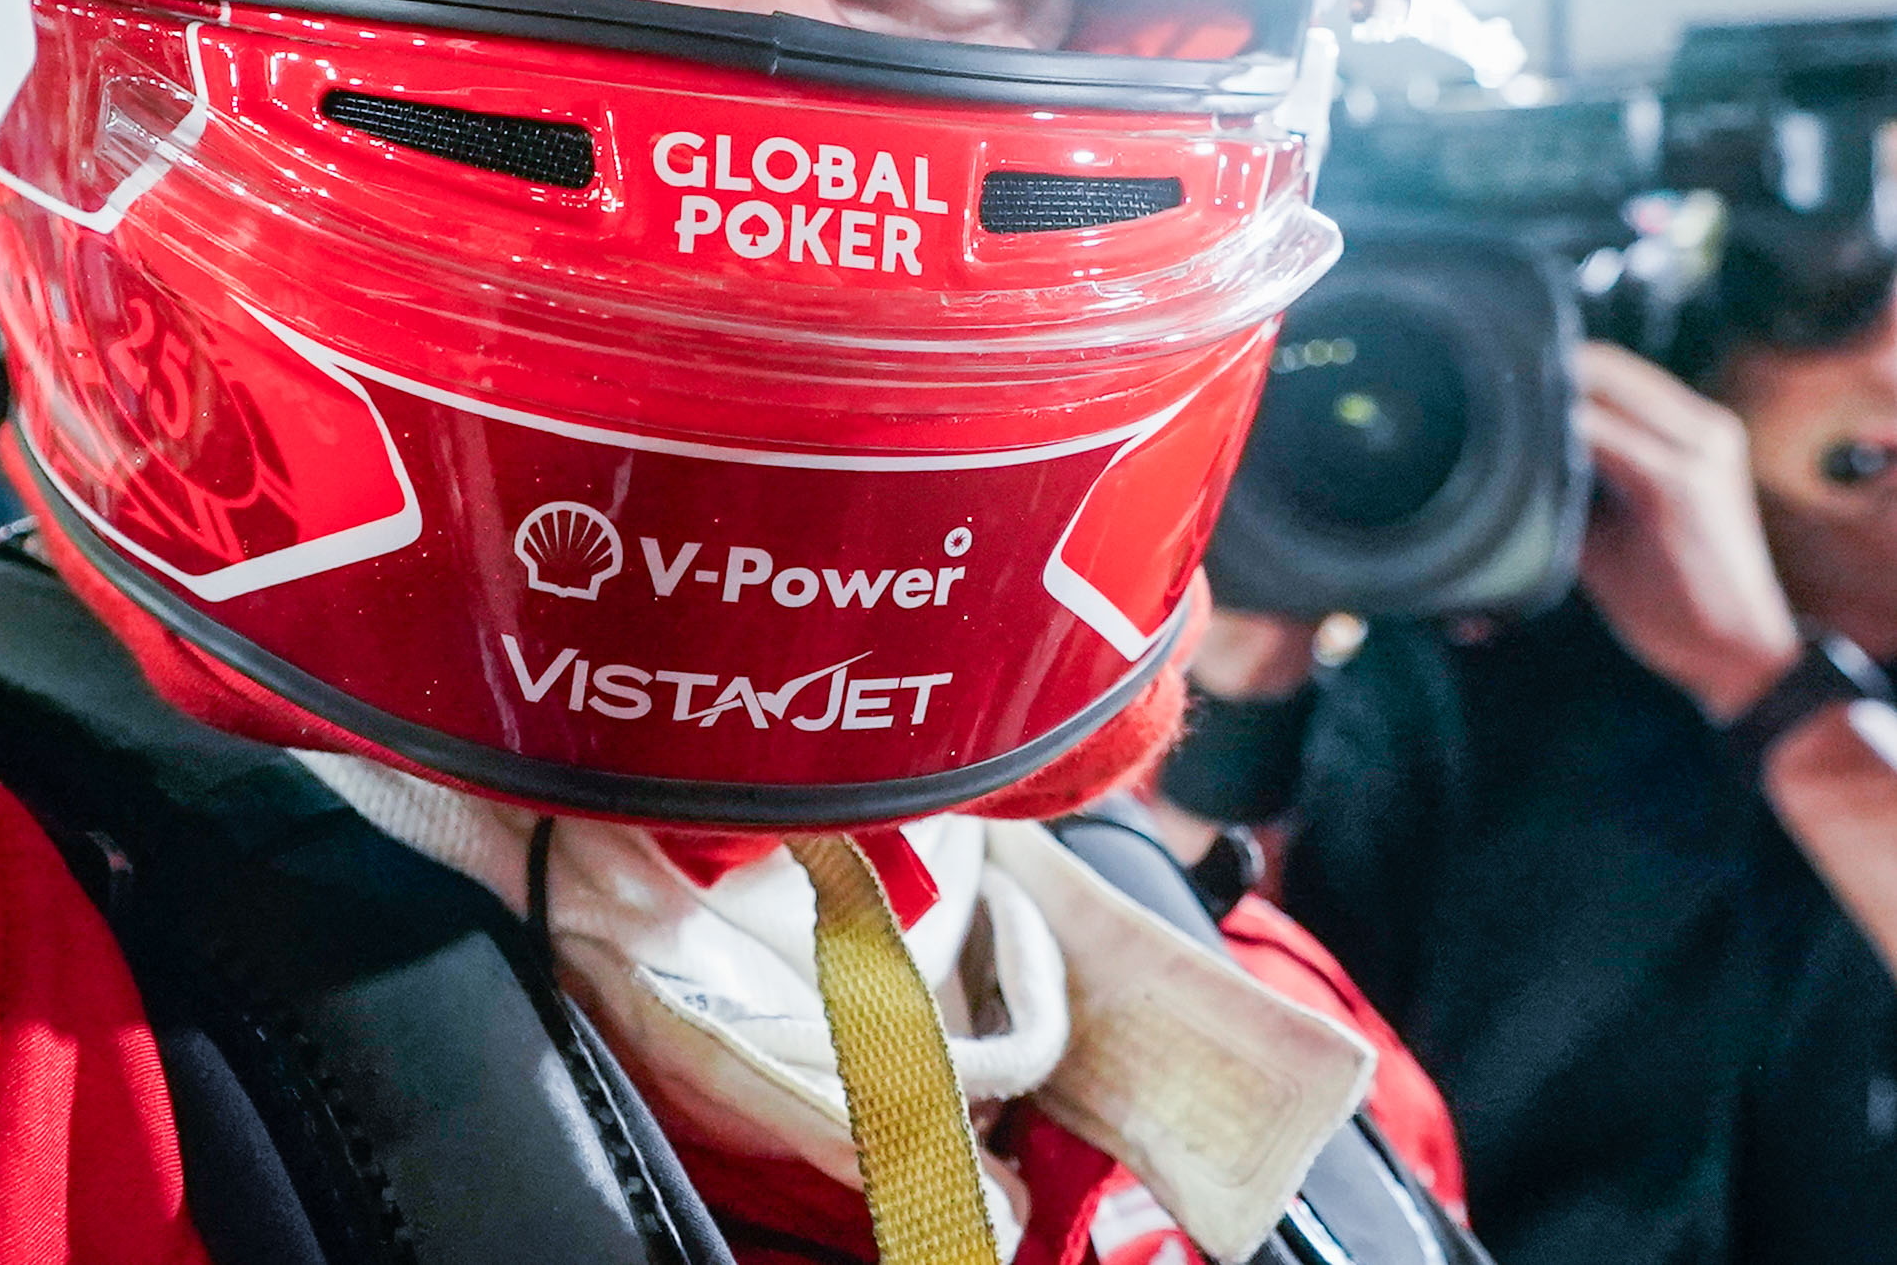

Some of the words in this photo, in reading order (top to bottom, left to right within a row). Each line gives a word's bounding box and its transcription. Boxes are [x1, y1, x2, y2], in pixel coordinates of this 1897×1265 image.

[652, 131, 949, 216] GLOBAL
[675, 200, 923, 277] POKER
[639, 536, 968, 609] V-Power
